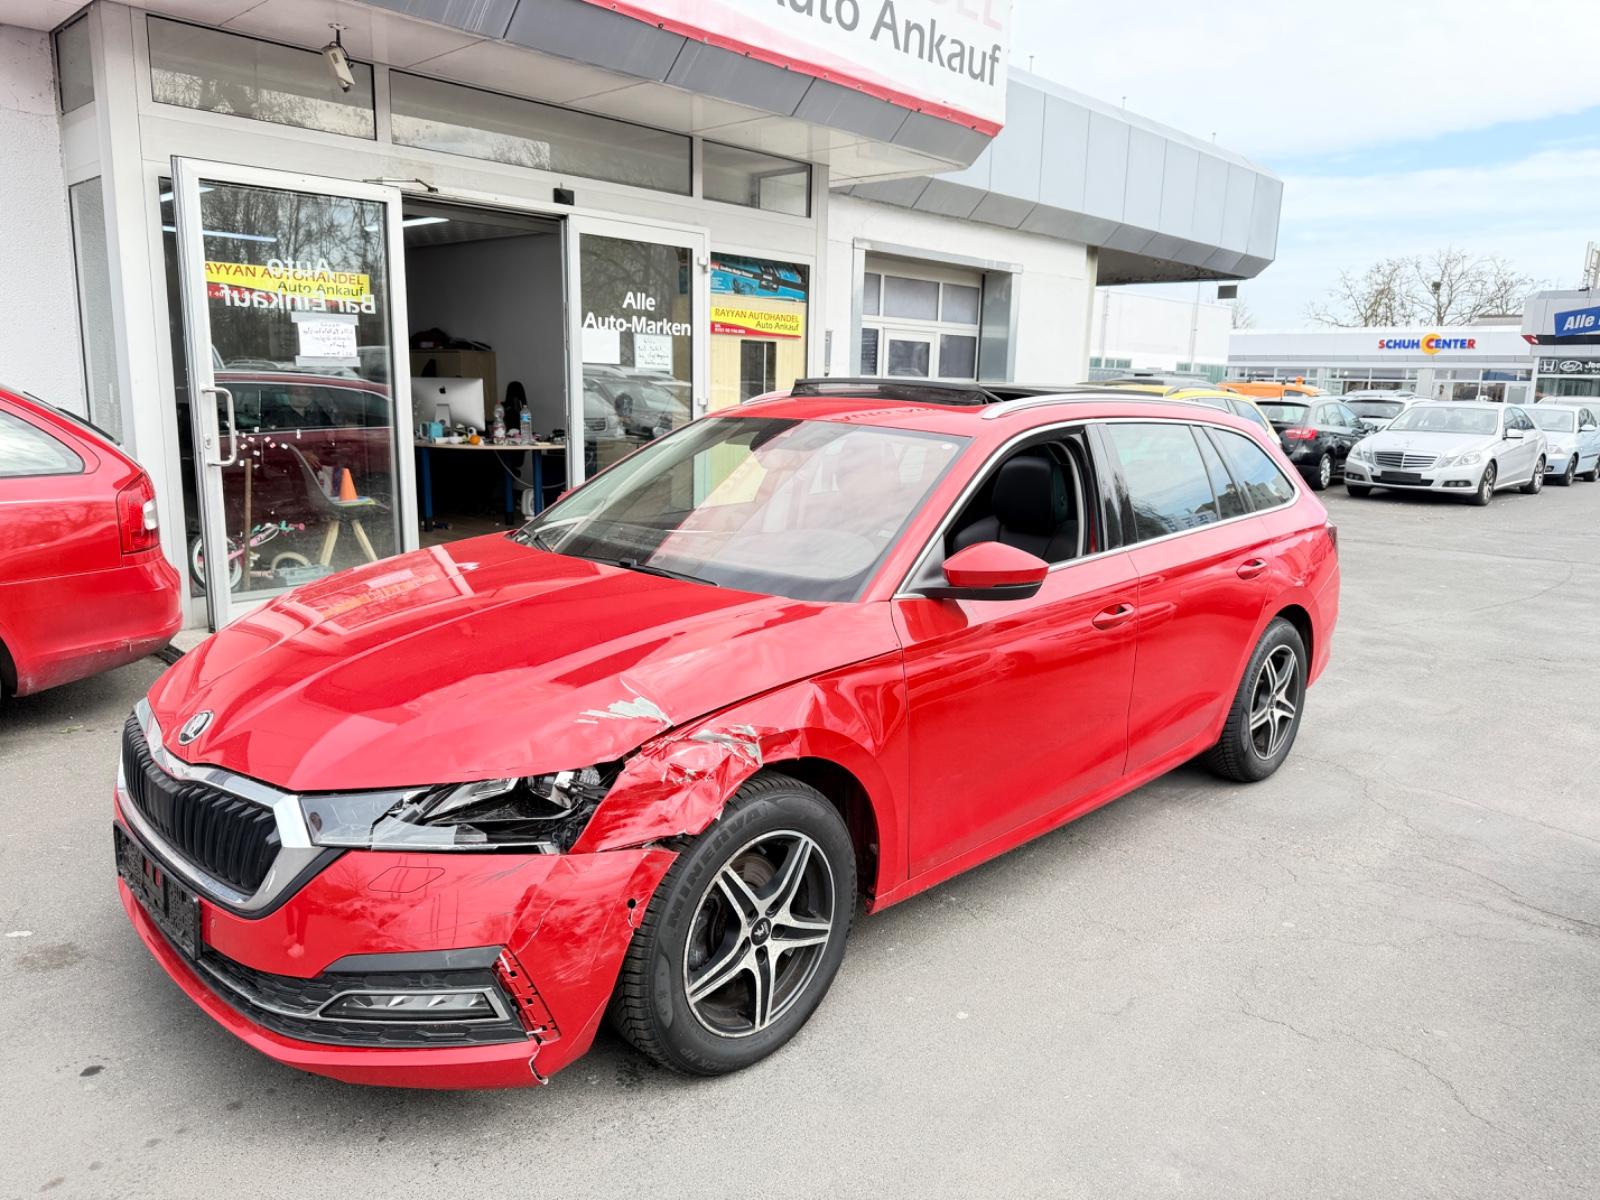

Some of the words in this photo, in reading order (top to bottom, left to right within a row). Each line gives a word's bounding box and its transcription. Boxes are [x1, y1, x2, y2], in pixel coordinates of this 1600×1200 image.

[776, 0, 860, 32] uto
[869, 0, 1002, 87] Ankauf
[205, 263, 257, 278] AYYAN
[278, 281, 312, 293] Auto
[316, 285, 364, 297] Ankauf
[622, 291, 656, 312] Alle
[714, 308, 747, 319] RAYYAN
[747, 310, 799, 323] AUTOHANDEL
[1563, 314, 1595, 331] Alle
[582, 312, 691, 337] Auto-Marken
[755, 321, 773, 330] Auto
[774, 322, 799, 332] Ankauf
[1378, 338, 1420, 350] SCHUH
[1426, 337, 1476, 350] CENTER
[667, 807, 766, 928] MINERVA
